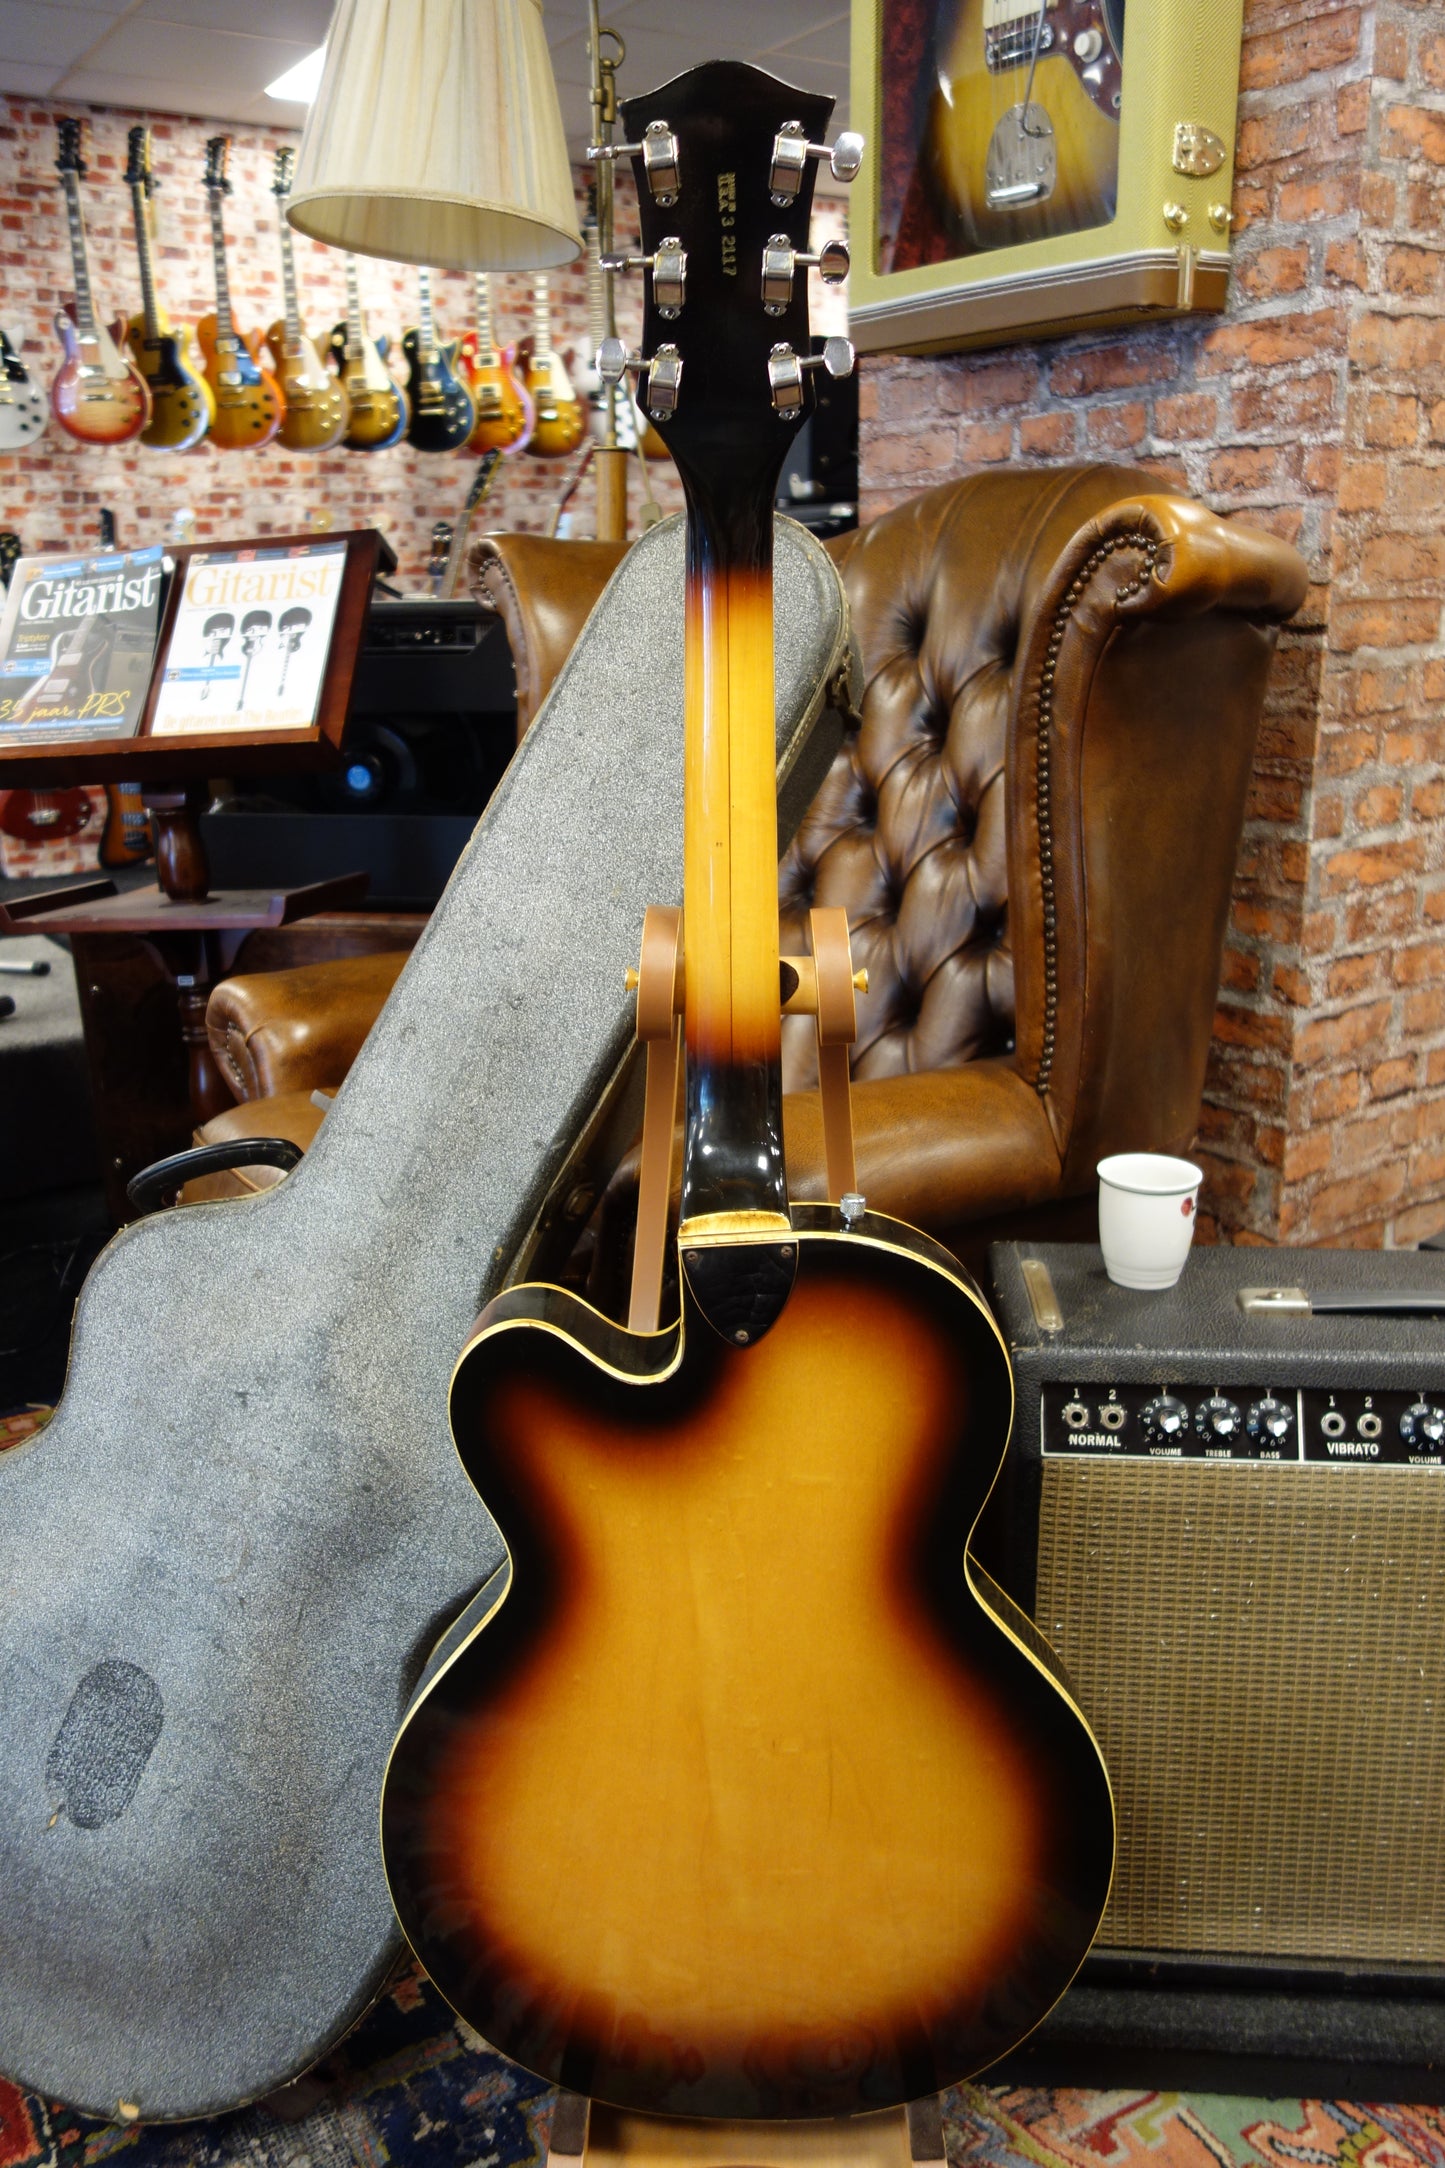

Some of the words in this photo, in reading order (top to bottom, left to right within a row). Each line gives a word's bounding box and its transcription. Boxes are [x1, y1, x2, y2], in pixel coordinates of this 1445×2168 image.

[723, 236, 737, 276] 2117
[186, 559, 342, 607] Gitarist
[20, 566, 162, 620] Gitarist
[0, 699, 24, 720] 35
[21, 705, 75, 729] jaar
[78, 690, 130, 720] PRS
[1073, 1388, 1080, 1399] 1
[1108, 1389, 1117, 1400] 2
[1329, 1395, 1336, 1407] 1
[1364, 1396, 1373, 1408] 2
[1068, 1433, 1121, 1447] NORMAL
[1149, 1447, 1182, 1456] VOLUME
[1205, 1449, 1232, 1458] TREBLE
[1260, 1451, 1280, 1460] BASS
[1327, 1442, 1379, 1456] VIBRATO
[1408, 1455, 1442, 1465] VOLUME
